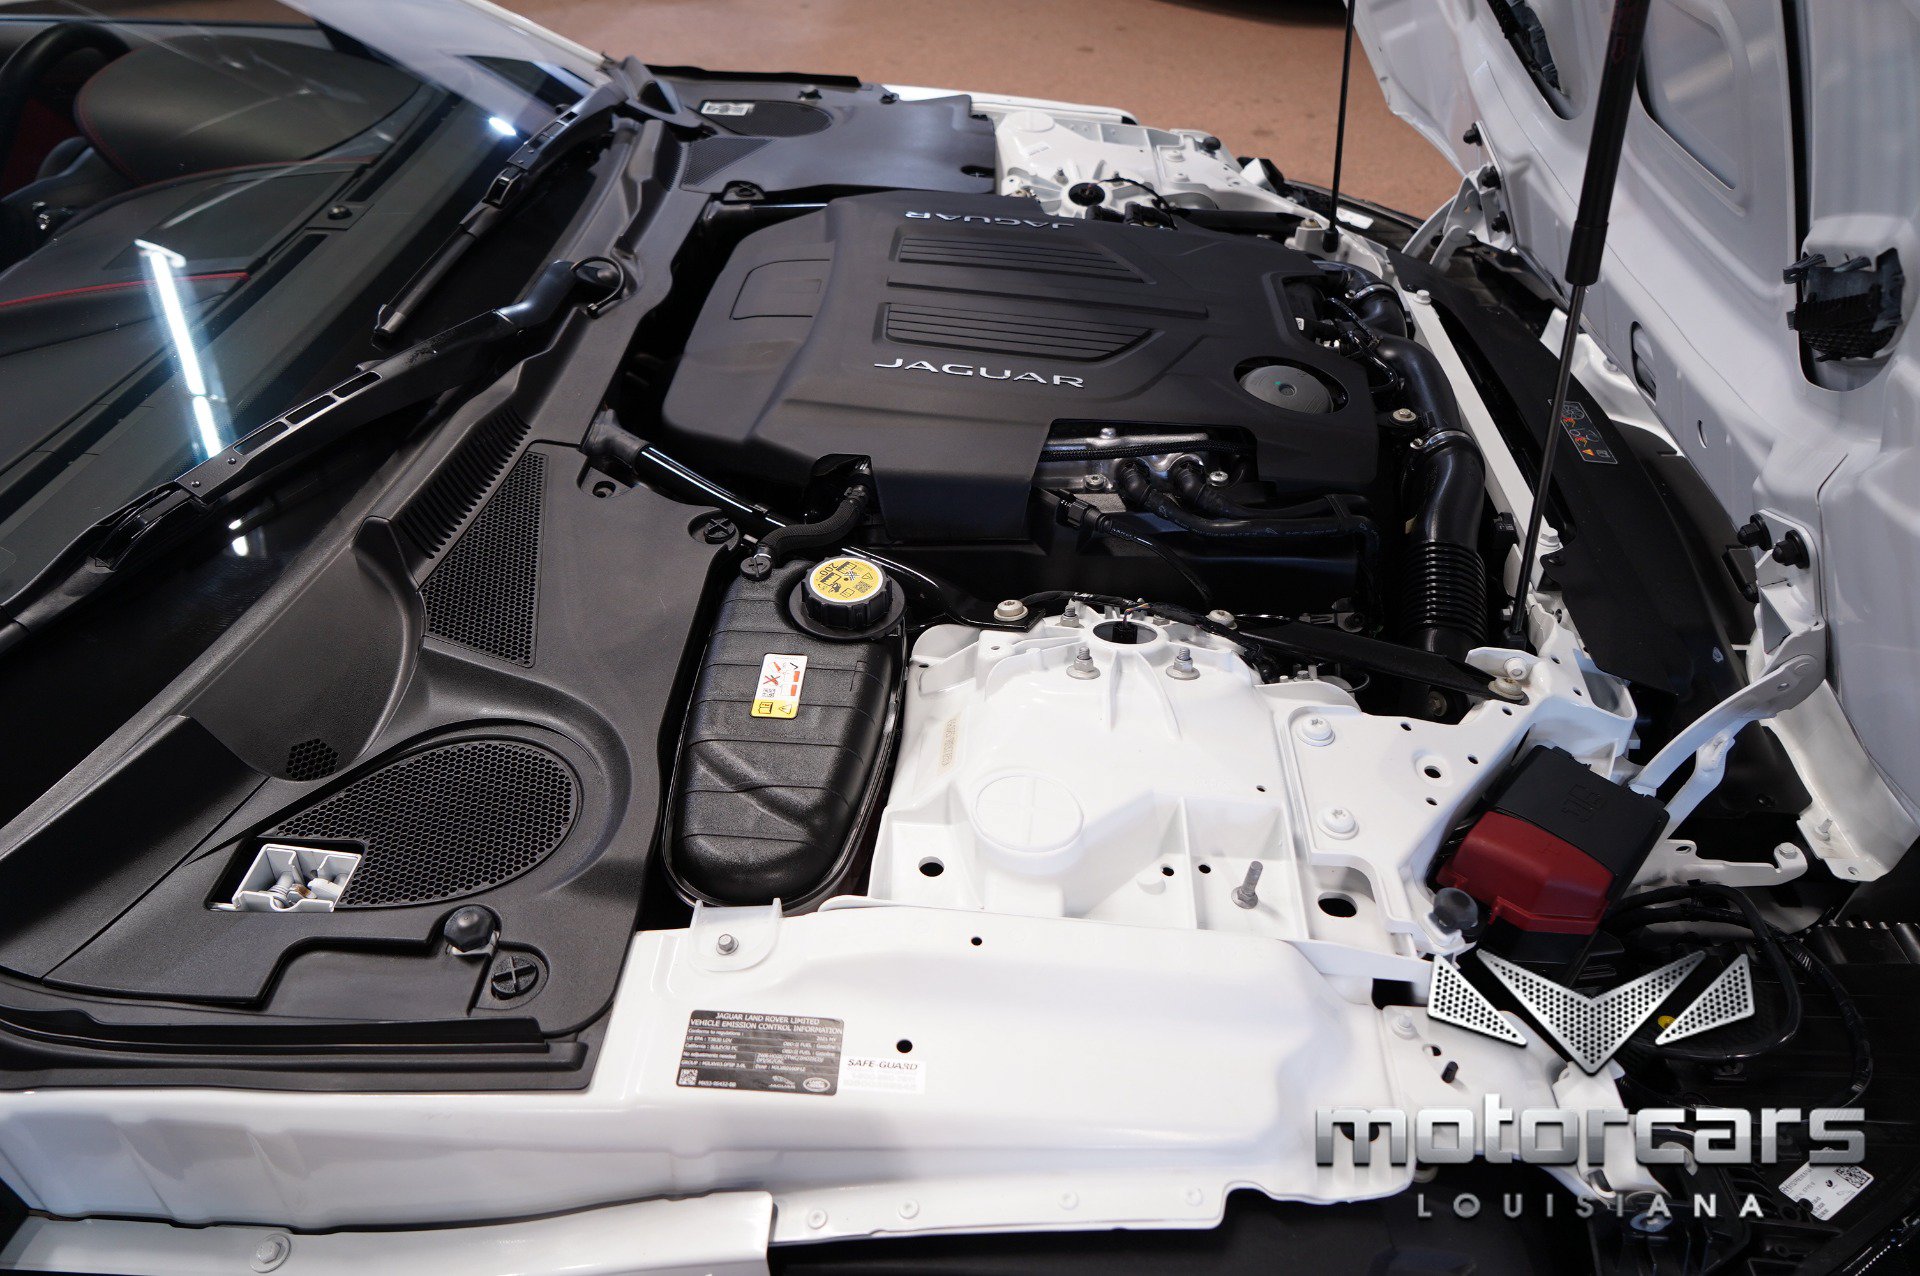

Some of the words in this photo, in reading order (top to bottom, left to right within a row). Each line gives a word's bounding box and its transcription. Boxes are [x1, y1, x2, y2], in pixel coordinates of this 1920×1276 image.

[905, 211, 1075, 229] JAGUAR
[874, 358, 1085, 388] JAGUAR
[722, 1020, 756, 1028] EMISSION
[793, 1025, 842, 1034] INFORMATION
[790, 1017, 820, 1025] LIMITED
